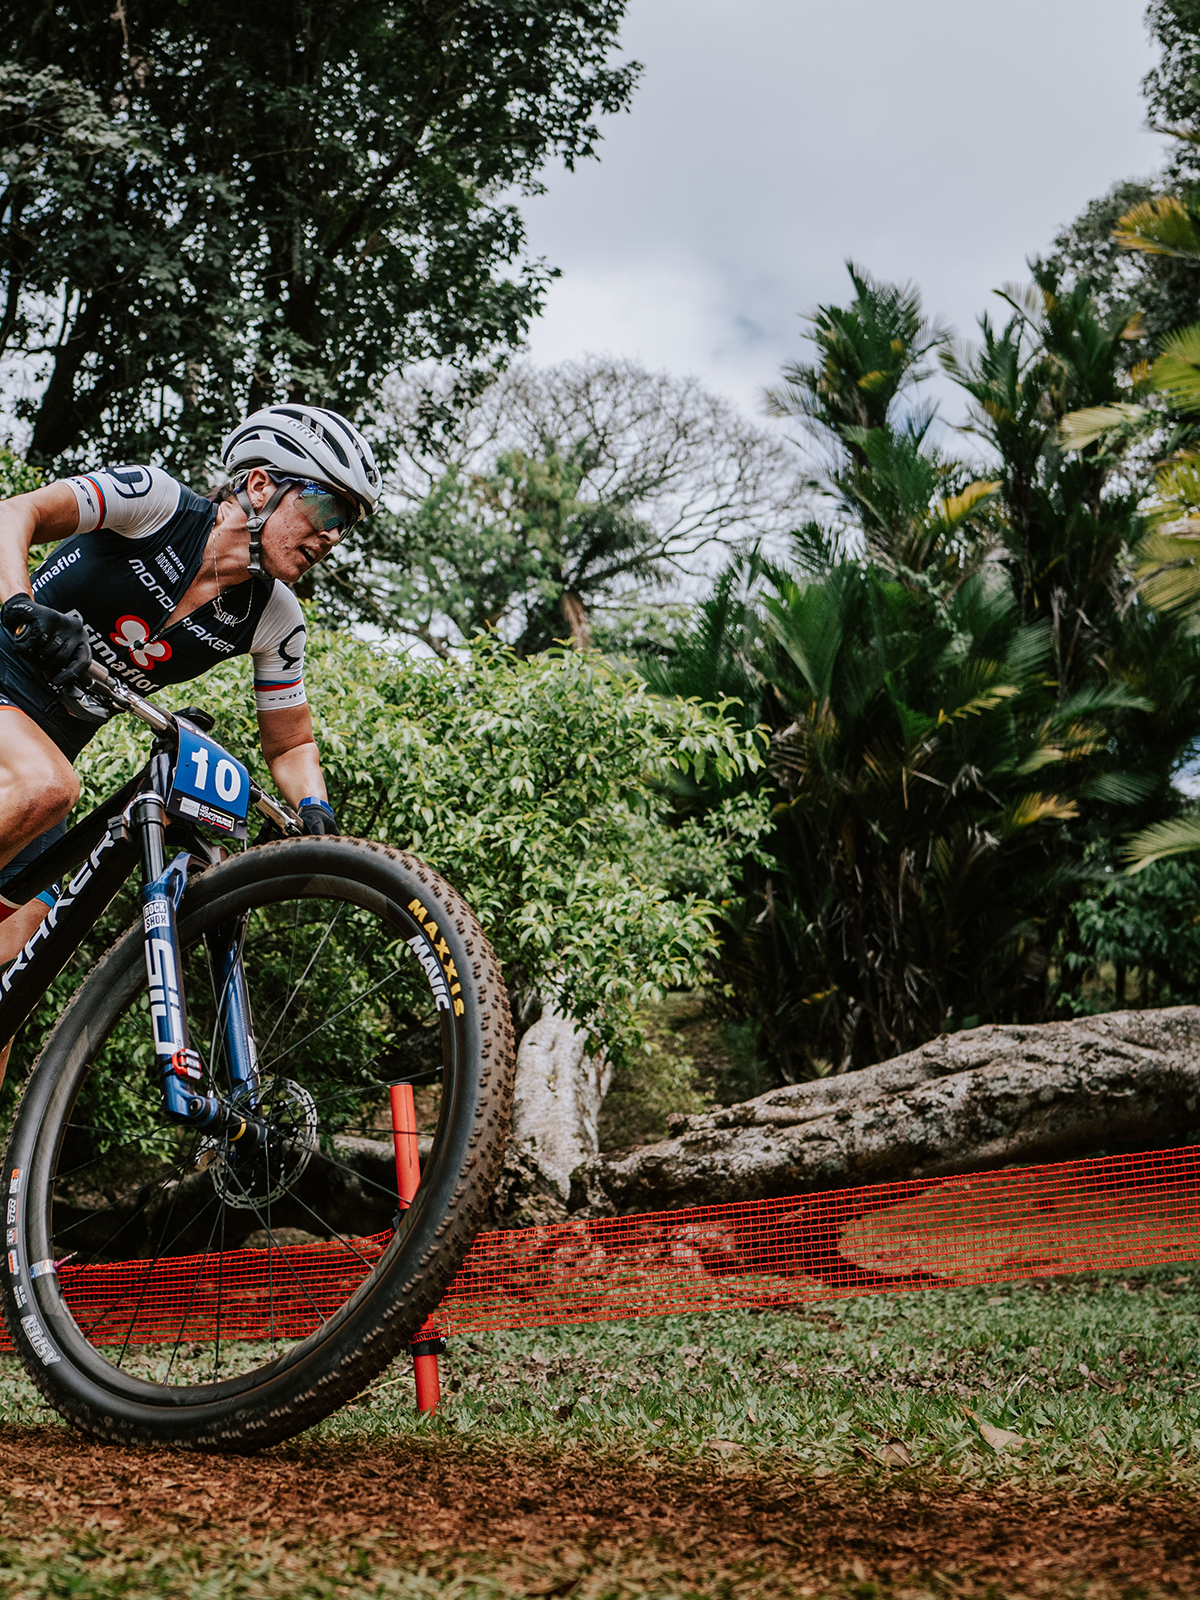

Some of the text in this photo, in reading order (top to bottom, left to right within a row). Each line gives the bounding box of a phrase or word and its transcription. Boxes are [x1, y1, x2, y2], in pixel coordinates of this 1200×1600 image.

[31, 547, 82, 595] rimaflor
[165, 545, 186, 573] SRAM
[191, 747, 241, 802] 10
[144, 902, 167, 918] ROCK
[145, 913, 168, 929] SHOX
[406, 934, 451, 1012] MAVIC
[407, 898, 465, 1017] MAXXIS
[21, 1314, 61, 1367] ASPEN
